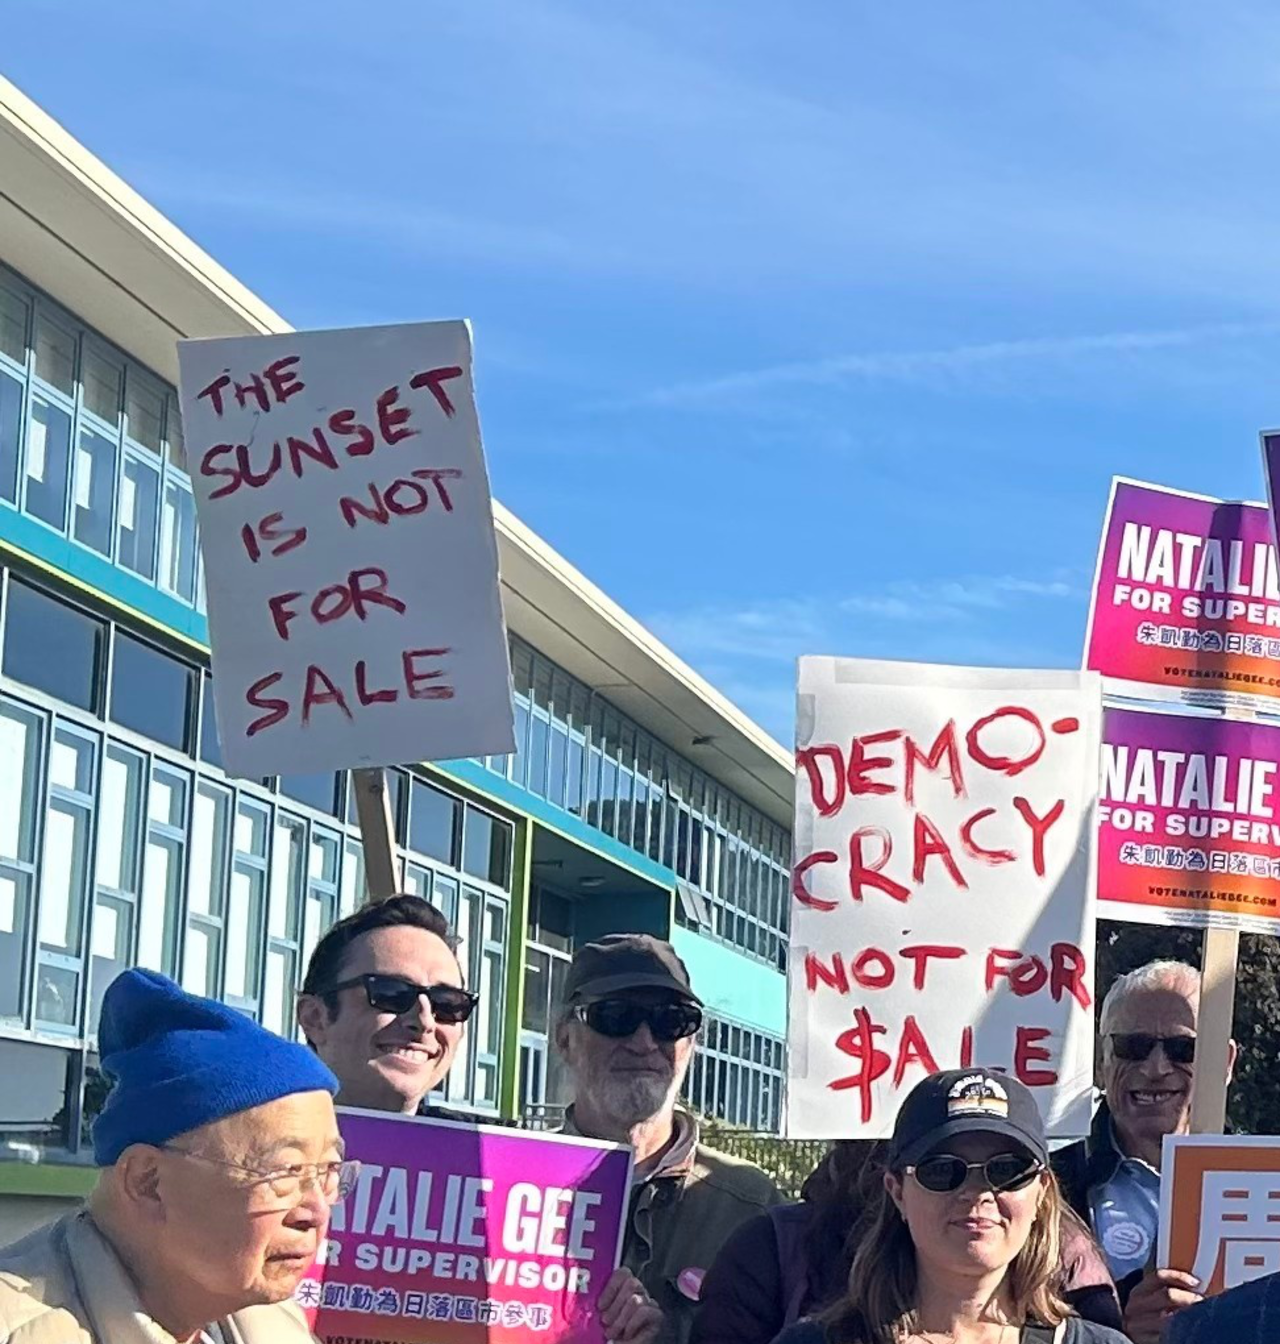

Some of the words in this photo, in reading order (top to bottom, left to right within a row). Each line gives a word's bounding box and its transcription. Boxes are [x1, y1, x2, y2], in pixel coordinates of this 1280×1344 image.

[197, 355, 306, 417] THE
[201, 366, 464, 499] SUNSET
[240, 511, 307, 563] IS
[340, 468, 463, 528] NOT
[268, 567, 407, 641] FOR
[1112, 583, 1172, 617] FOR
[246, 647, 456, 737] SALE
[796, 705, 1080, 818] DEMO-
[1100, 743, 1277, 819] NATALIE
[794, 796, 1065, 911] CRACY
[1098, 805, 1155, 833] FOR
[805, 944, 968, 996] NOT
[984, 942, 1092, 1011] FOR
[502, 1180, 603, 1261] GEE
[355, 1242, 592, 1294] SUPERVISOR
